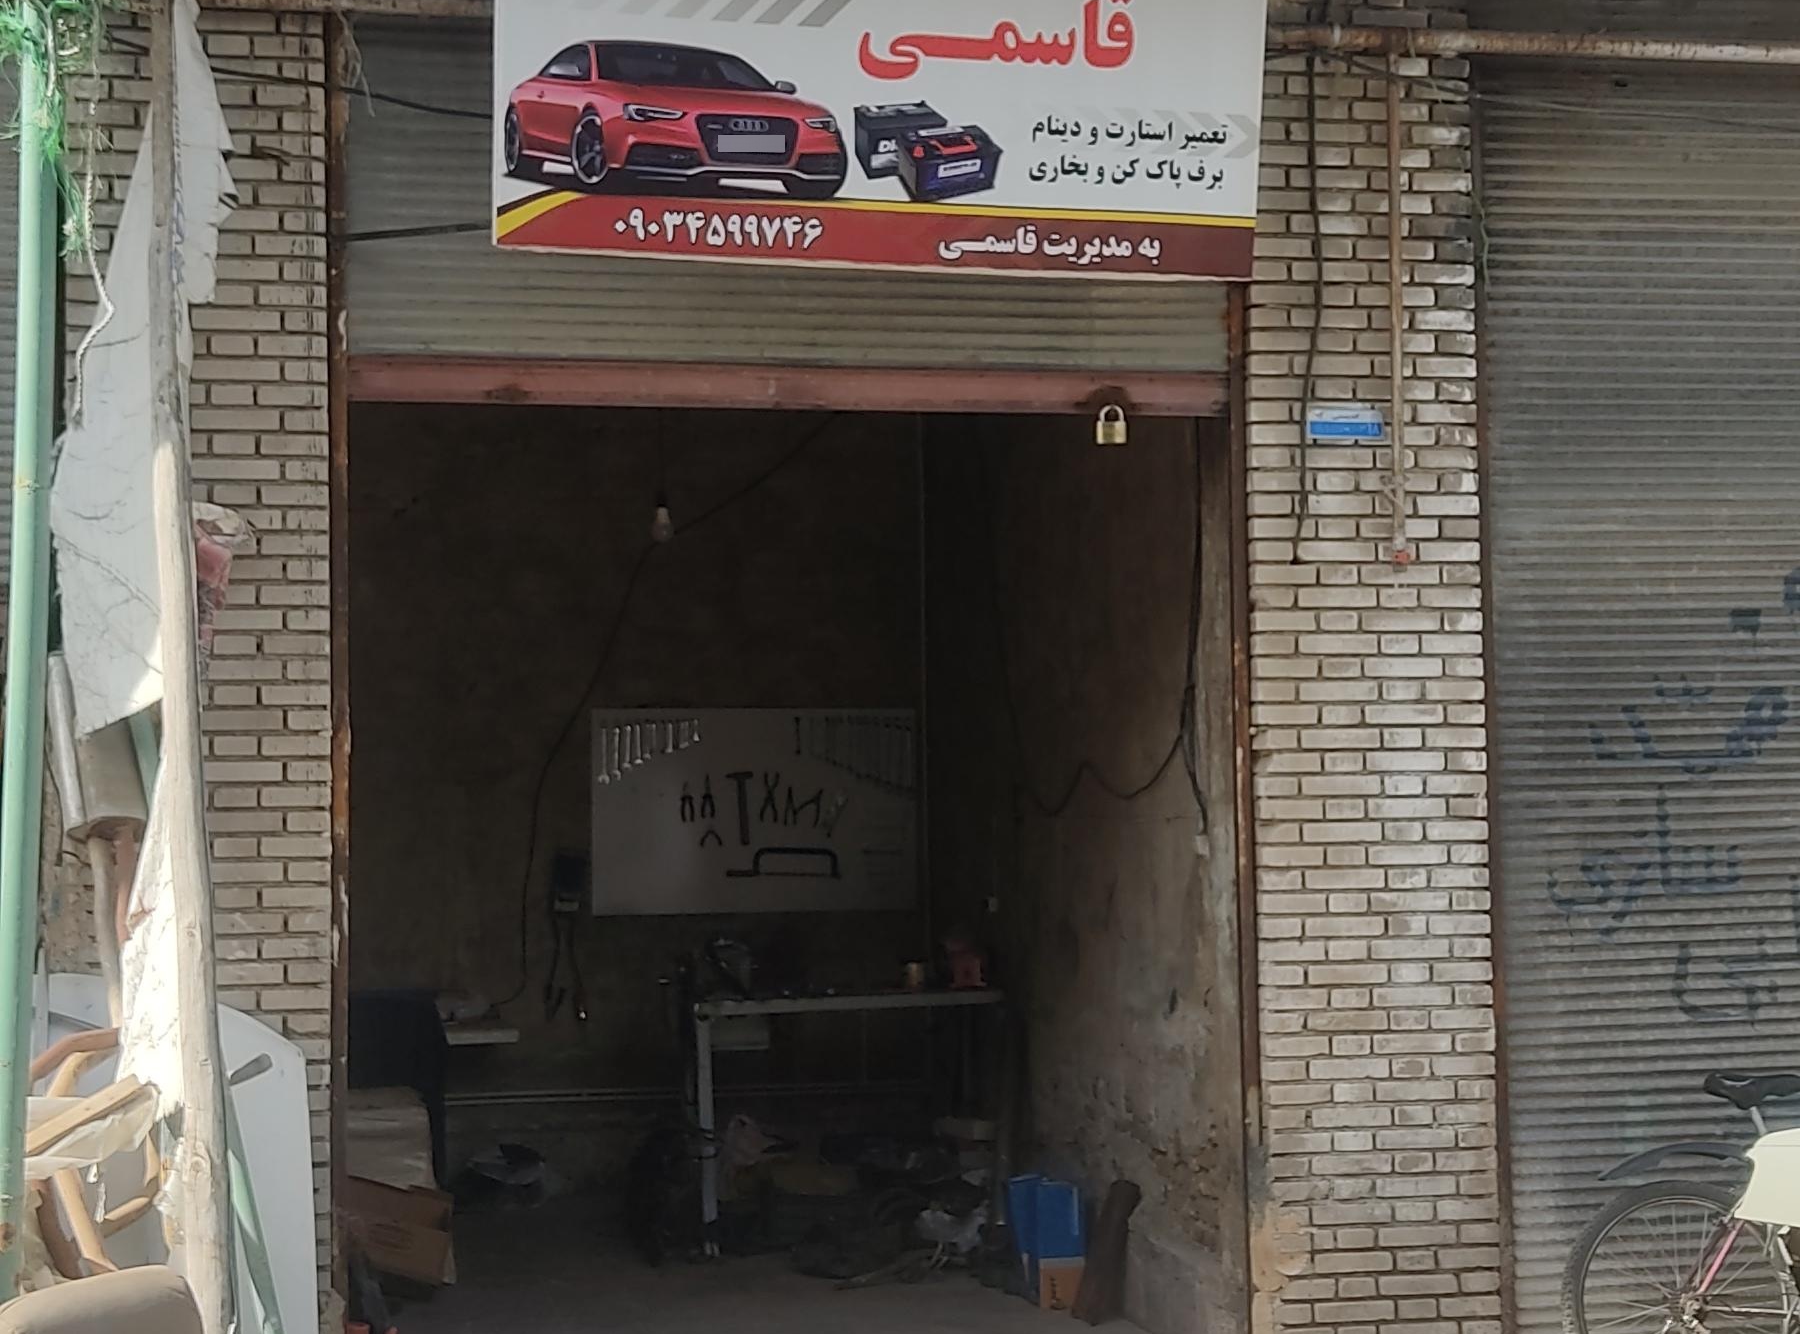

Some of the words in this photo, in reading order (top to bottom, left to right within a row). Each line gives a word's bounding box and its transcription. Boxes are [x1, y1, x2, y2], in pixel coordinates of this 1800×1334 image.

[1032, 115, 1081, 142] دینام
[1087, 126, 1098, 146] و
[1105, 119, 1173, 147] استارت
[1178, 124, 1228, 150] تعمیر
[1028, 154, 1089, 183] بخاری
[1094, 165, 1105, 184] و
[1111, 157, 1141, 185] کن
[1146, 159, 1181, 189] پاک
[1187, 160, 1224, 190] برف
[614, 207, 824, 250] ۰۹۰۳۴۵۹۹۷۴۶
[938, 224, 1038, 260] قاسمی
[1042, 234, 1133, 265] مدیریت
[1138, 236, 1161, 266] به
